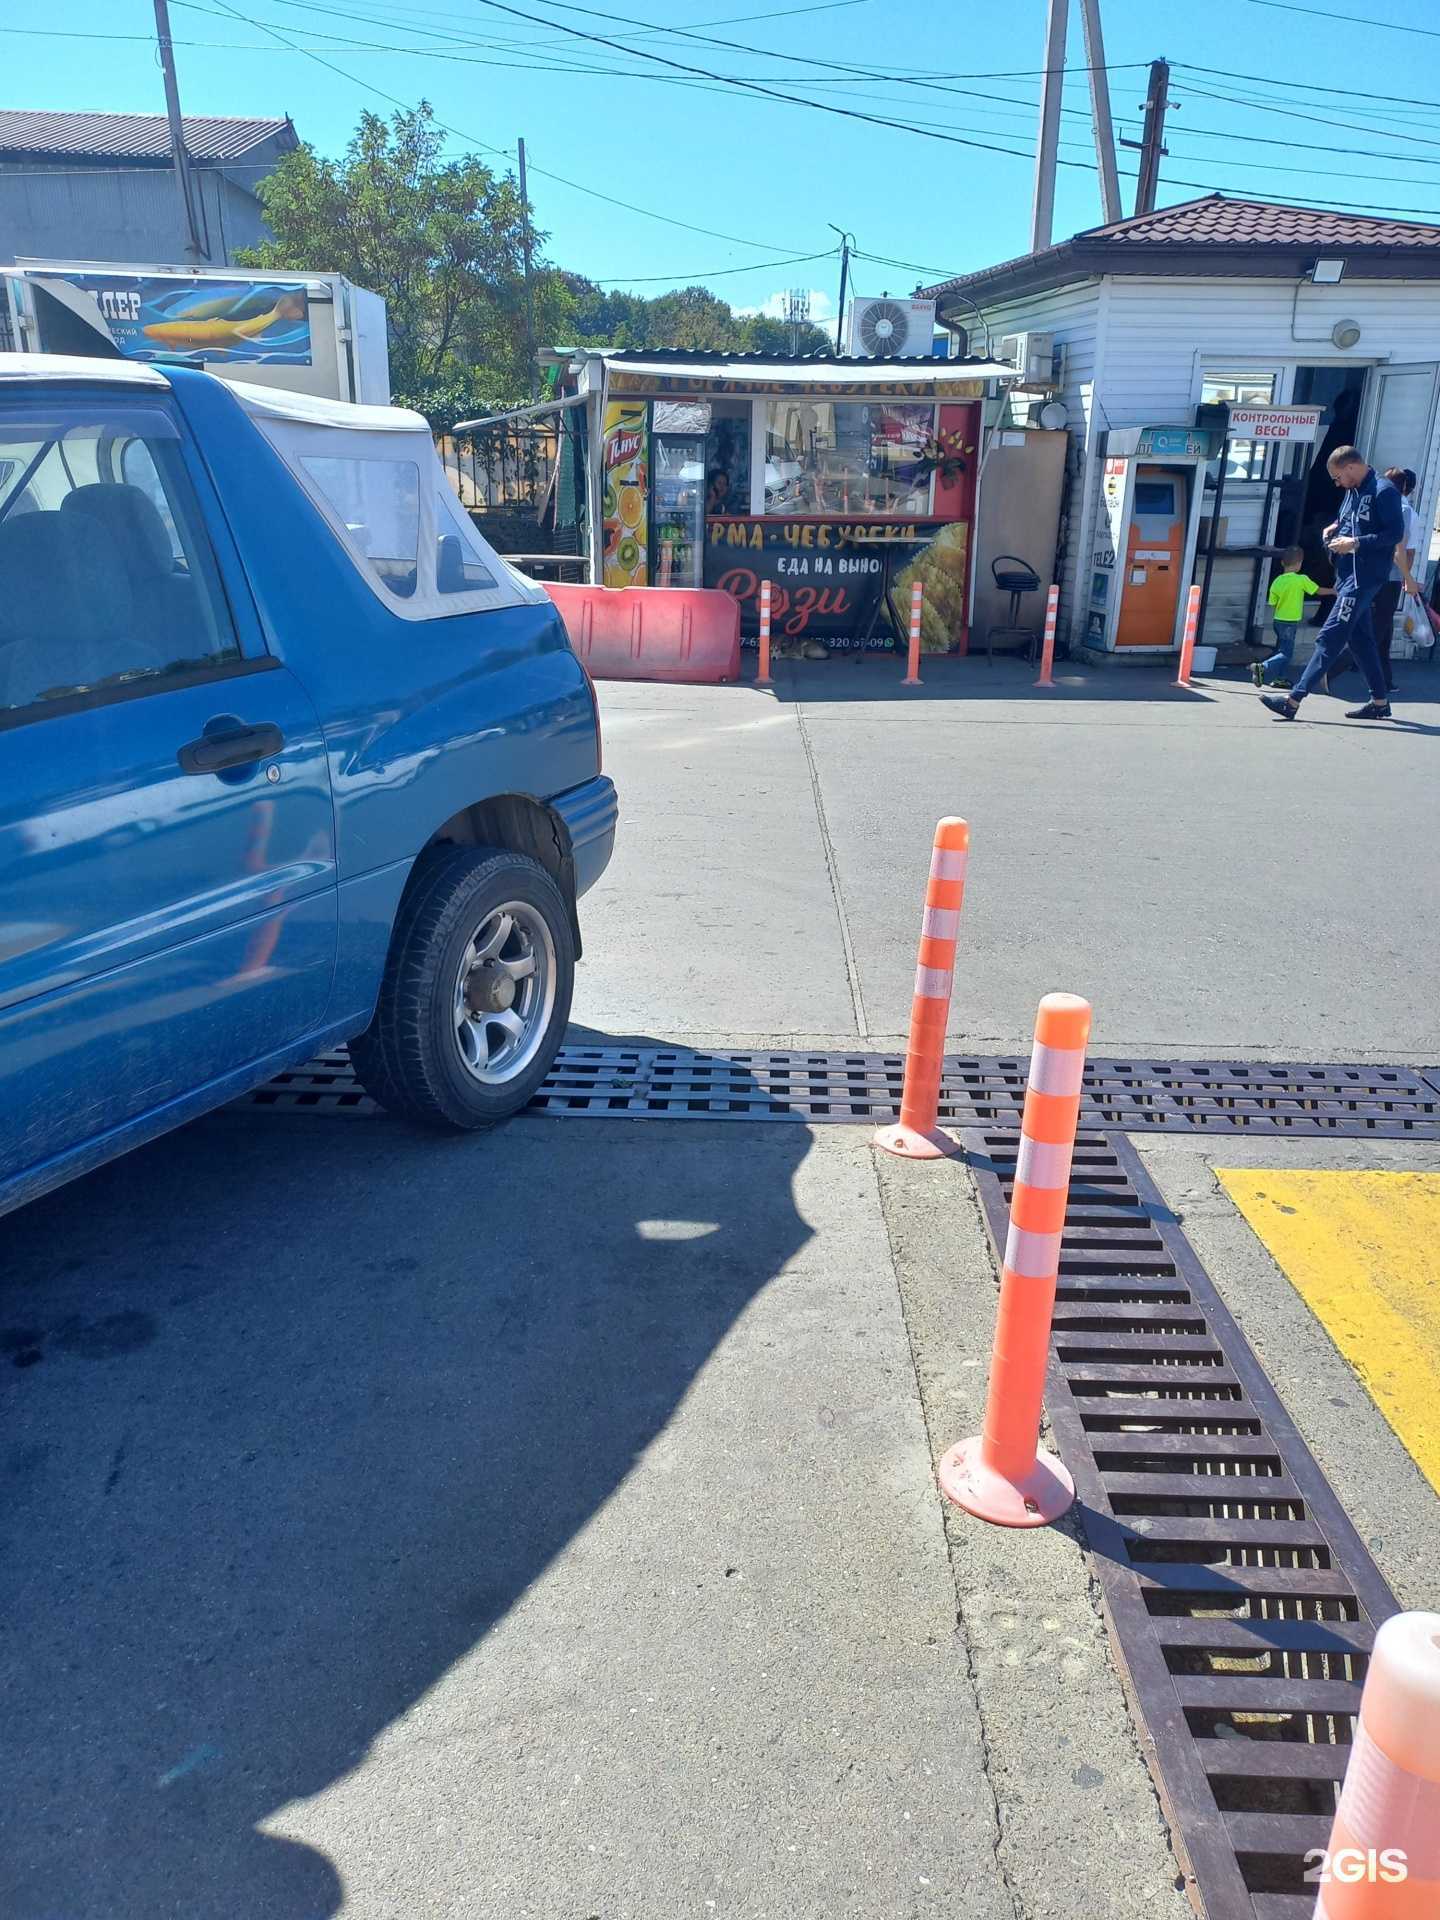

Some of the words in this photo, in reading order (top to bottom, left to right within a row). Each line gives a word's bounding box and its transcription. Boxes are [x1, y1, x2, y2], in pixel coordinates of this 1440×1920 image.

[1232, 412, 1316, 425] КОНТРОЛЬНЫЕ
[1255, 425, 1290, 437] ВЕСЫ
[706, 523, 763, 550] РМА
[777, 557, 809, 575] ЕДА
[814, 557, 833, 575] НА
[838, 557, 883, 574] ВЫНО
